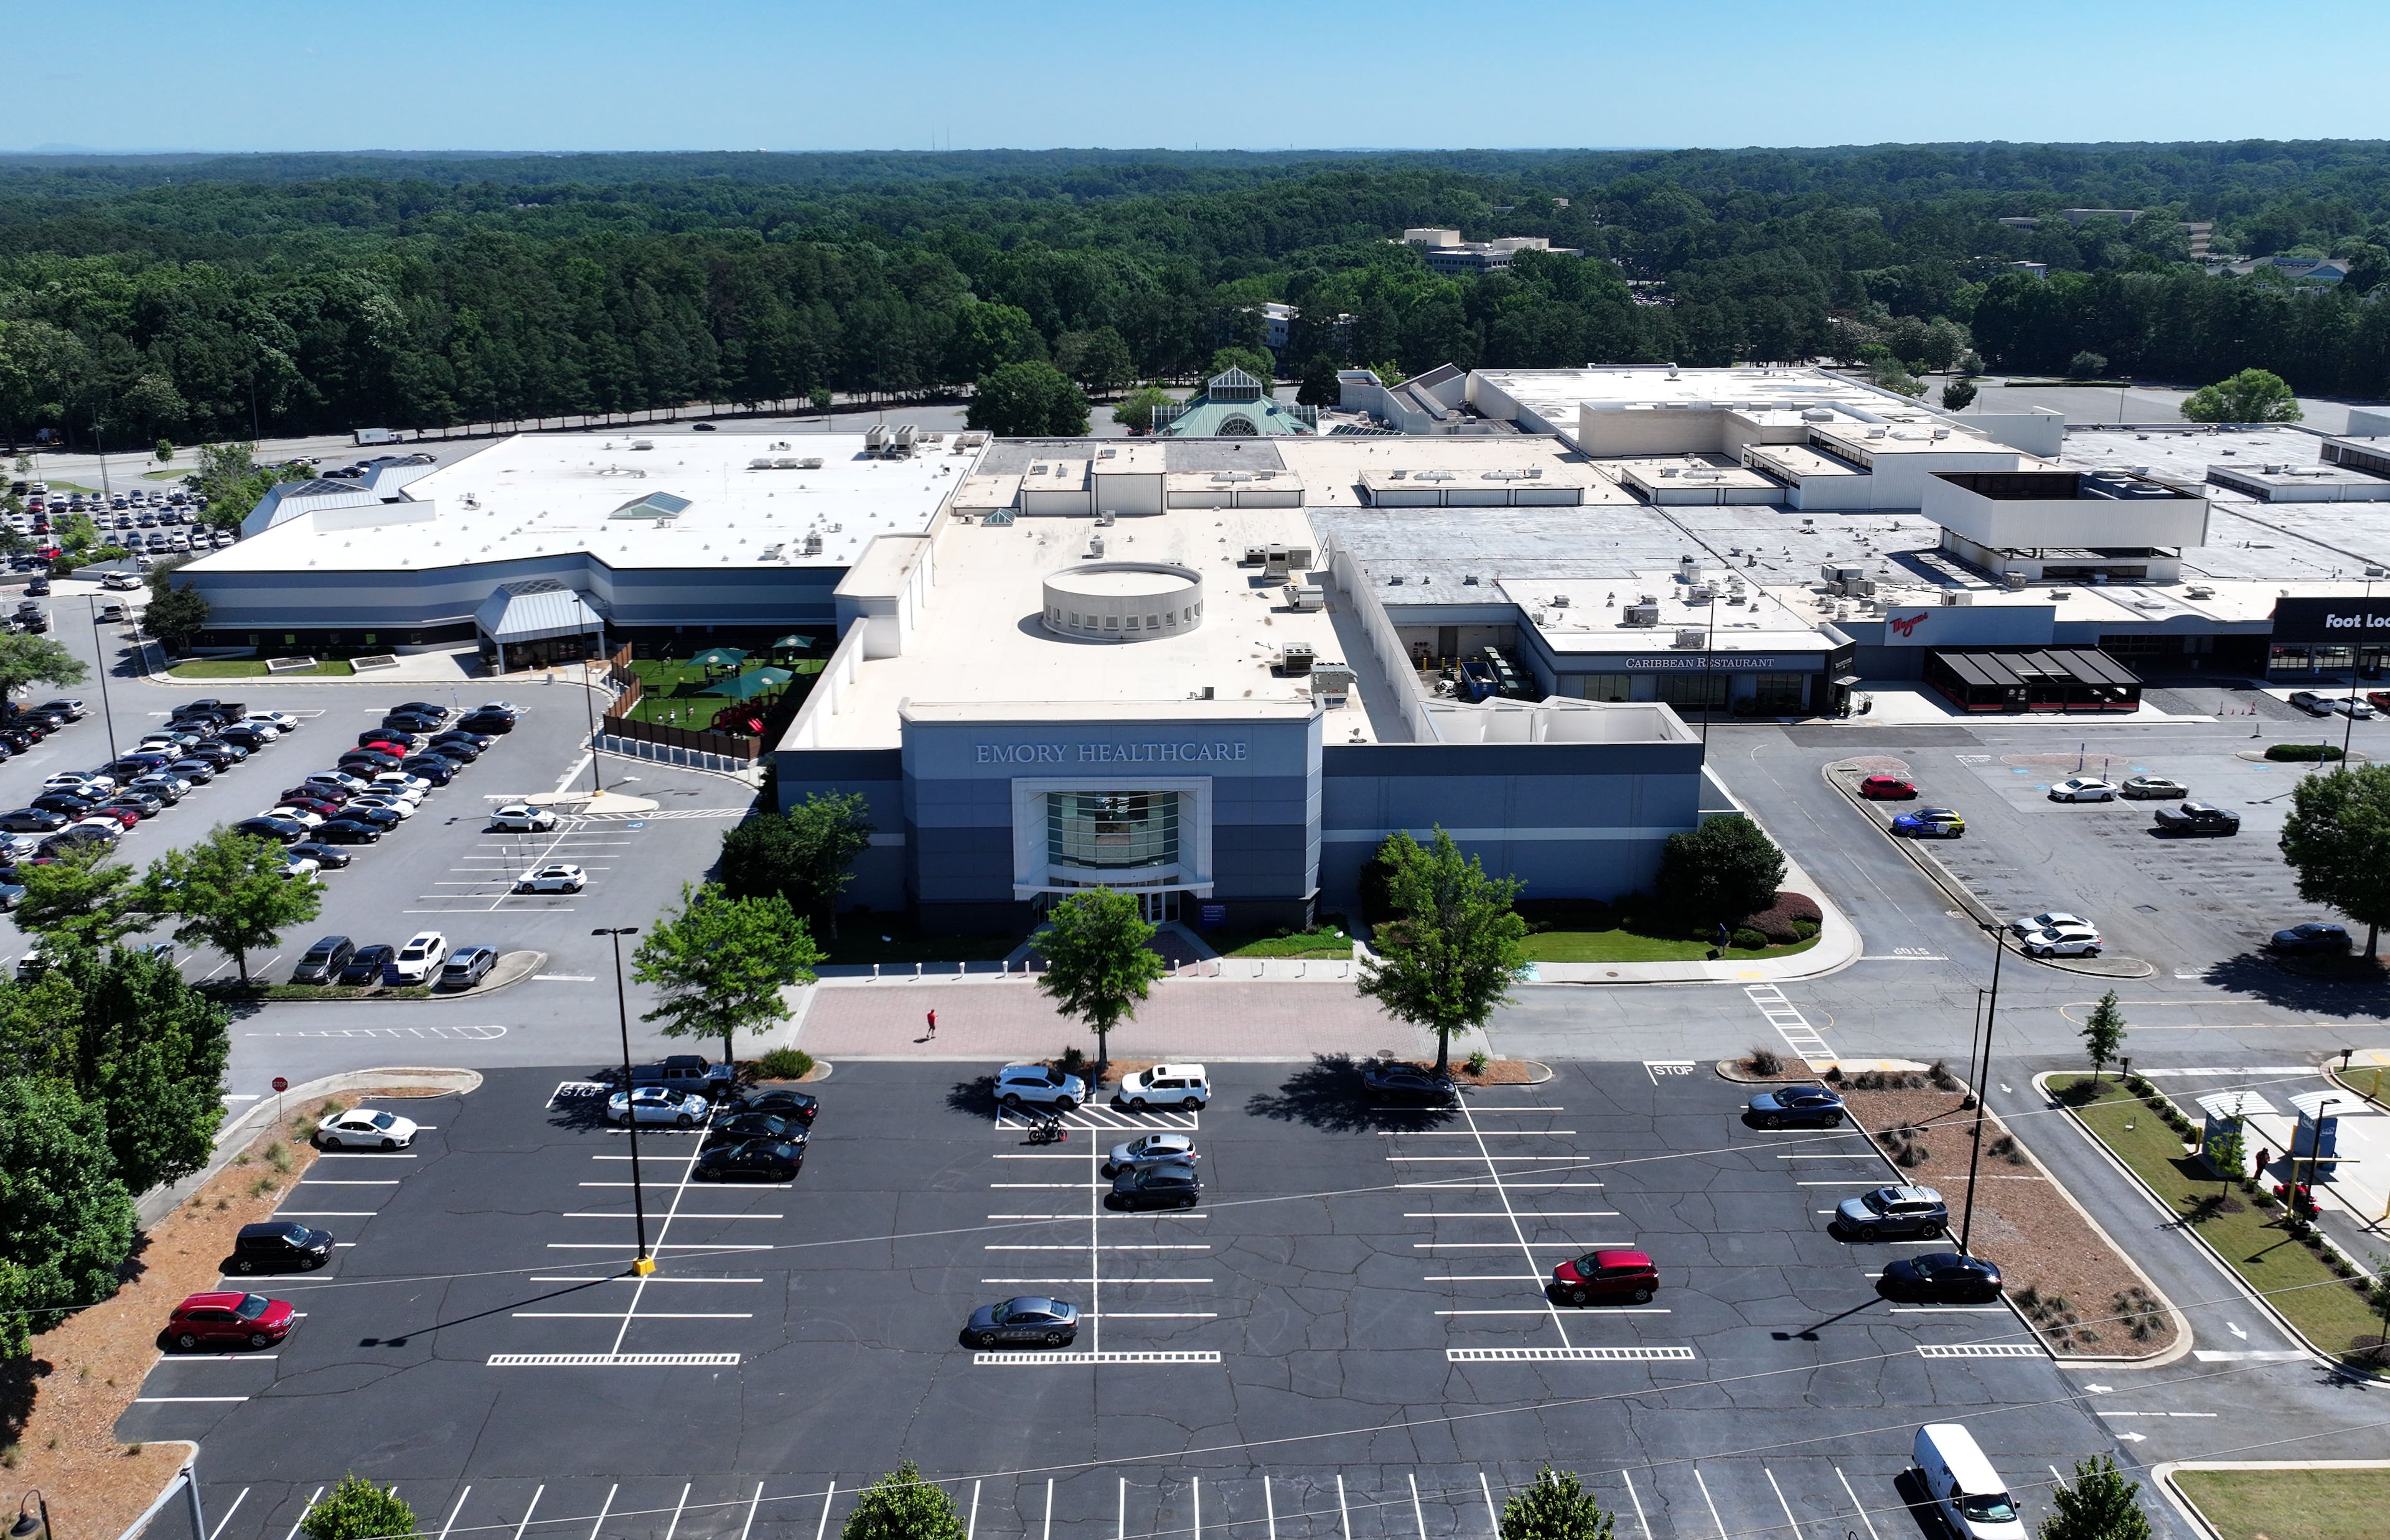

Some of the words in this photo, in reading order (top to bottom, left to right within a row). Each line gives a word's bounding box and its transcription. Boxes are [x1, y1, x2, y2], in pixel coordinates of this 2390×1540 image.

[2325, 614, 2361, 628] Foot
[1625, 658, 1694, 668] CARIBBEAN
[1696, 657, 1774, 668] RESTAURANT
[975, 744, 1068, 763] EMORY
[1077, 742, 1248, 763] HEALTHCARE
[1652, 1065, 1694, 1075] STOP
[560, 1087, 606, 1097] STOP
